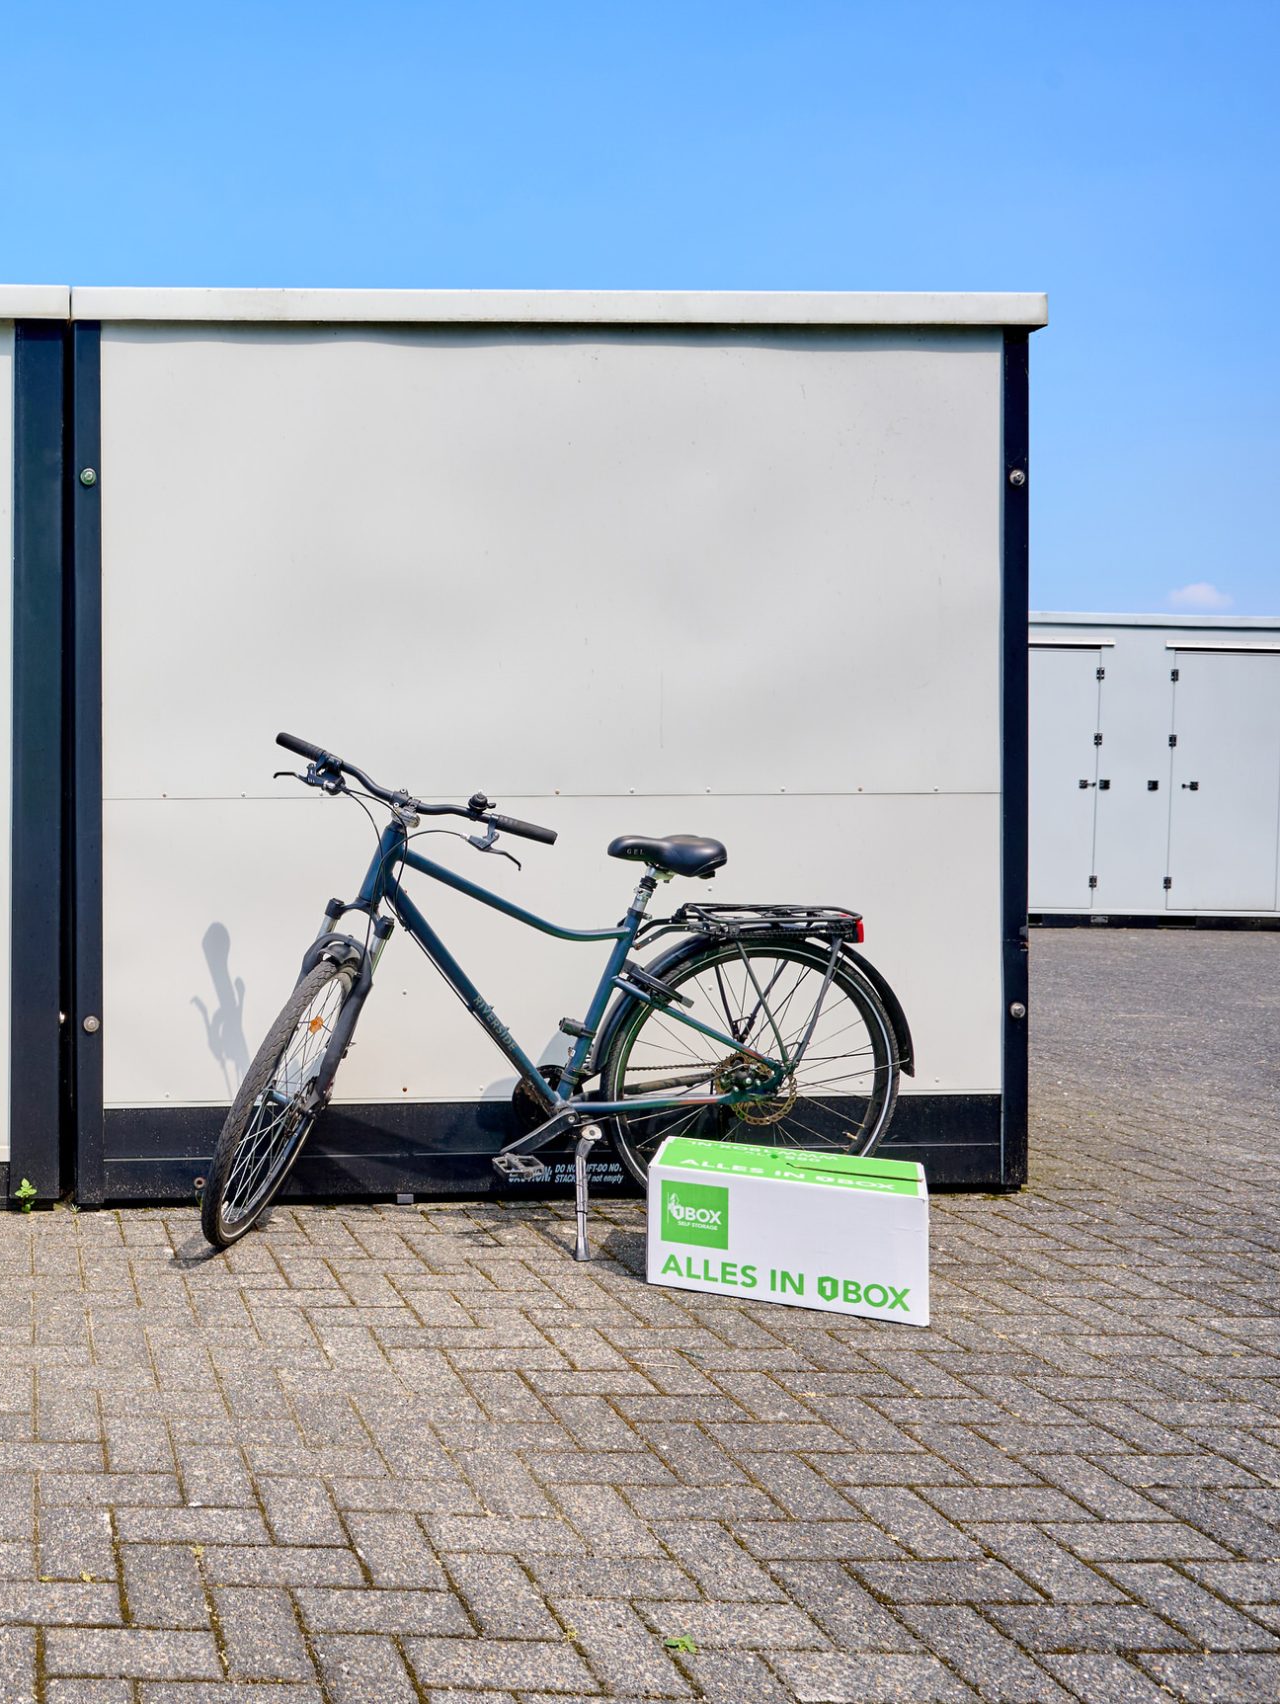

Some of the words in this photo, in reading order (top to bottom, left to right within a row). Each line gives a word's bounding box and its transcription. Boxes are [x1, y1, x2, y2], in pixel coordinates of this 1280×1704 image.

[473, 995, 518, 1051] RIVERSIDE
[554, 1164, 566, 1173] DO
[680, 1159, 764, 1174] ALLES
[774, 1170, 805, 1179] IN
[603, 1175, 624, 1184] empty
[691, 1223, 719, 1231] STORAGE
[661, 1254, 758, 1288] ALLES
[770, 1269, 805, 1296] IN
